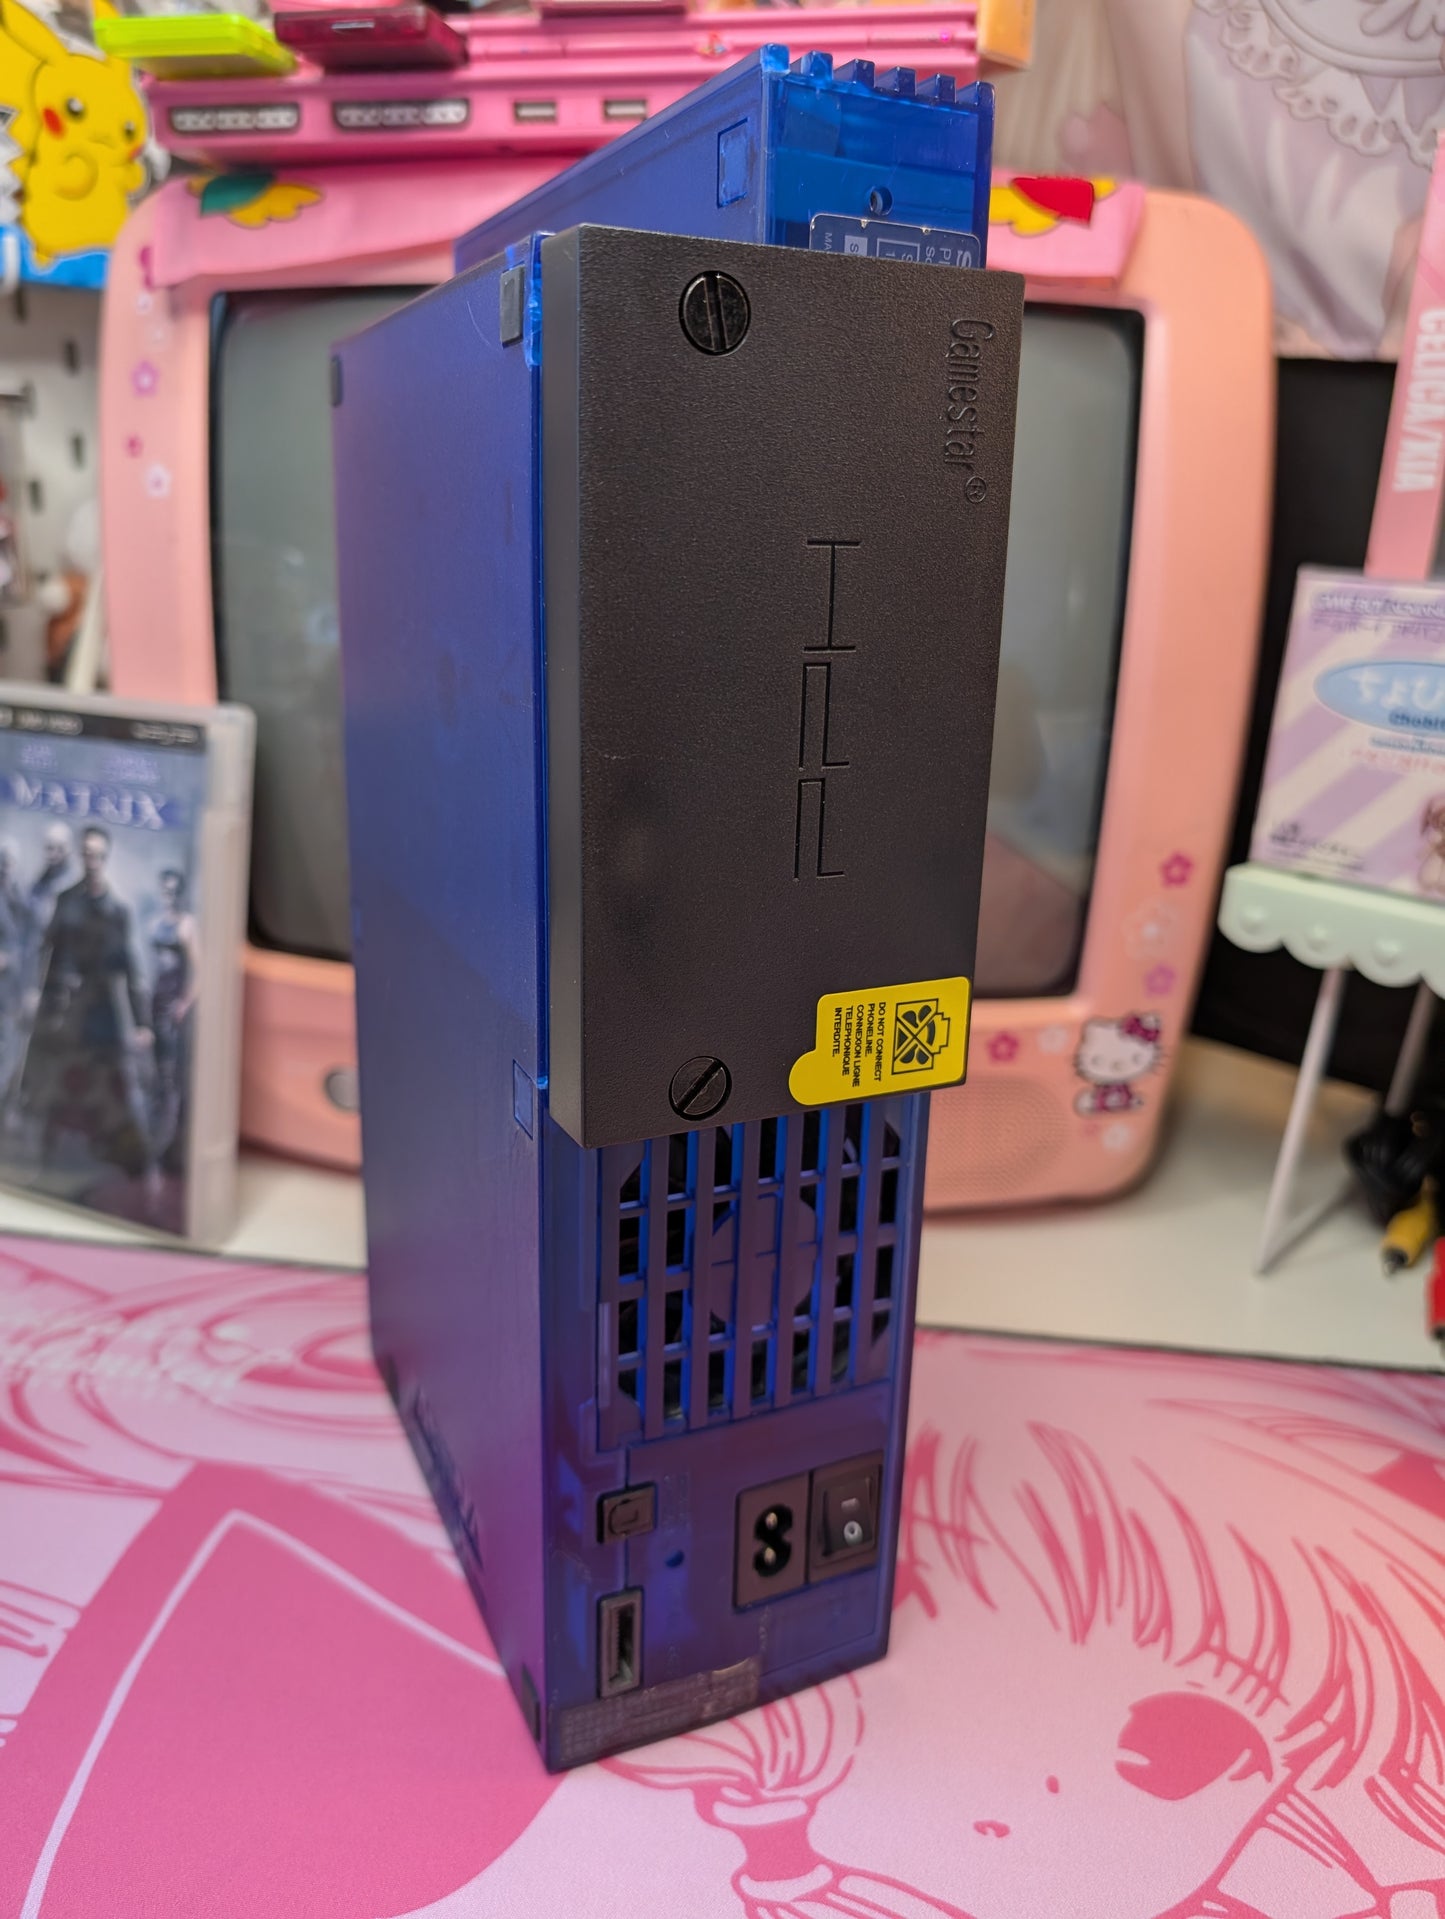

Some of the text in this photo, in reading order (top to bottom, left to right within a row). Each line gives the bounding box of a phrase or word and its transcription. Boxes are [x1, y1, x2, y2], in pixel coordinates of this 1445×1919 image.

[879, 1002, 886, 1015] DO
[842, 1005, 853, 1076] TELEPHONIQUE
[852, 1004, 864, 1087] CONNEXION LIGNE
[874, 1038, 884, 1082] CONNECT
